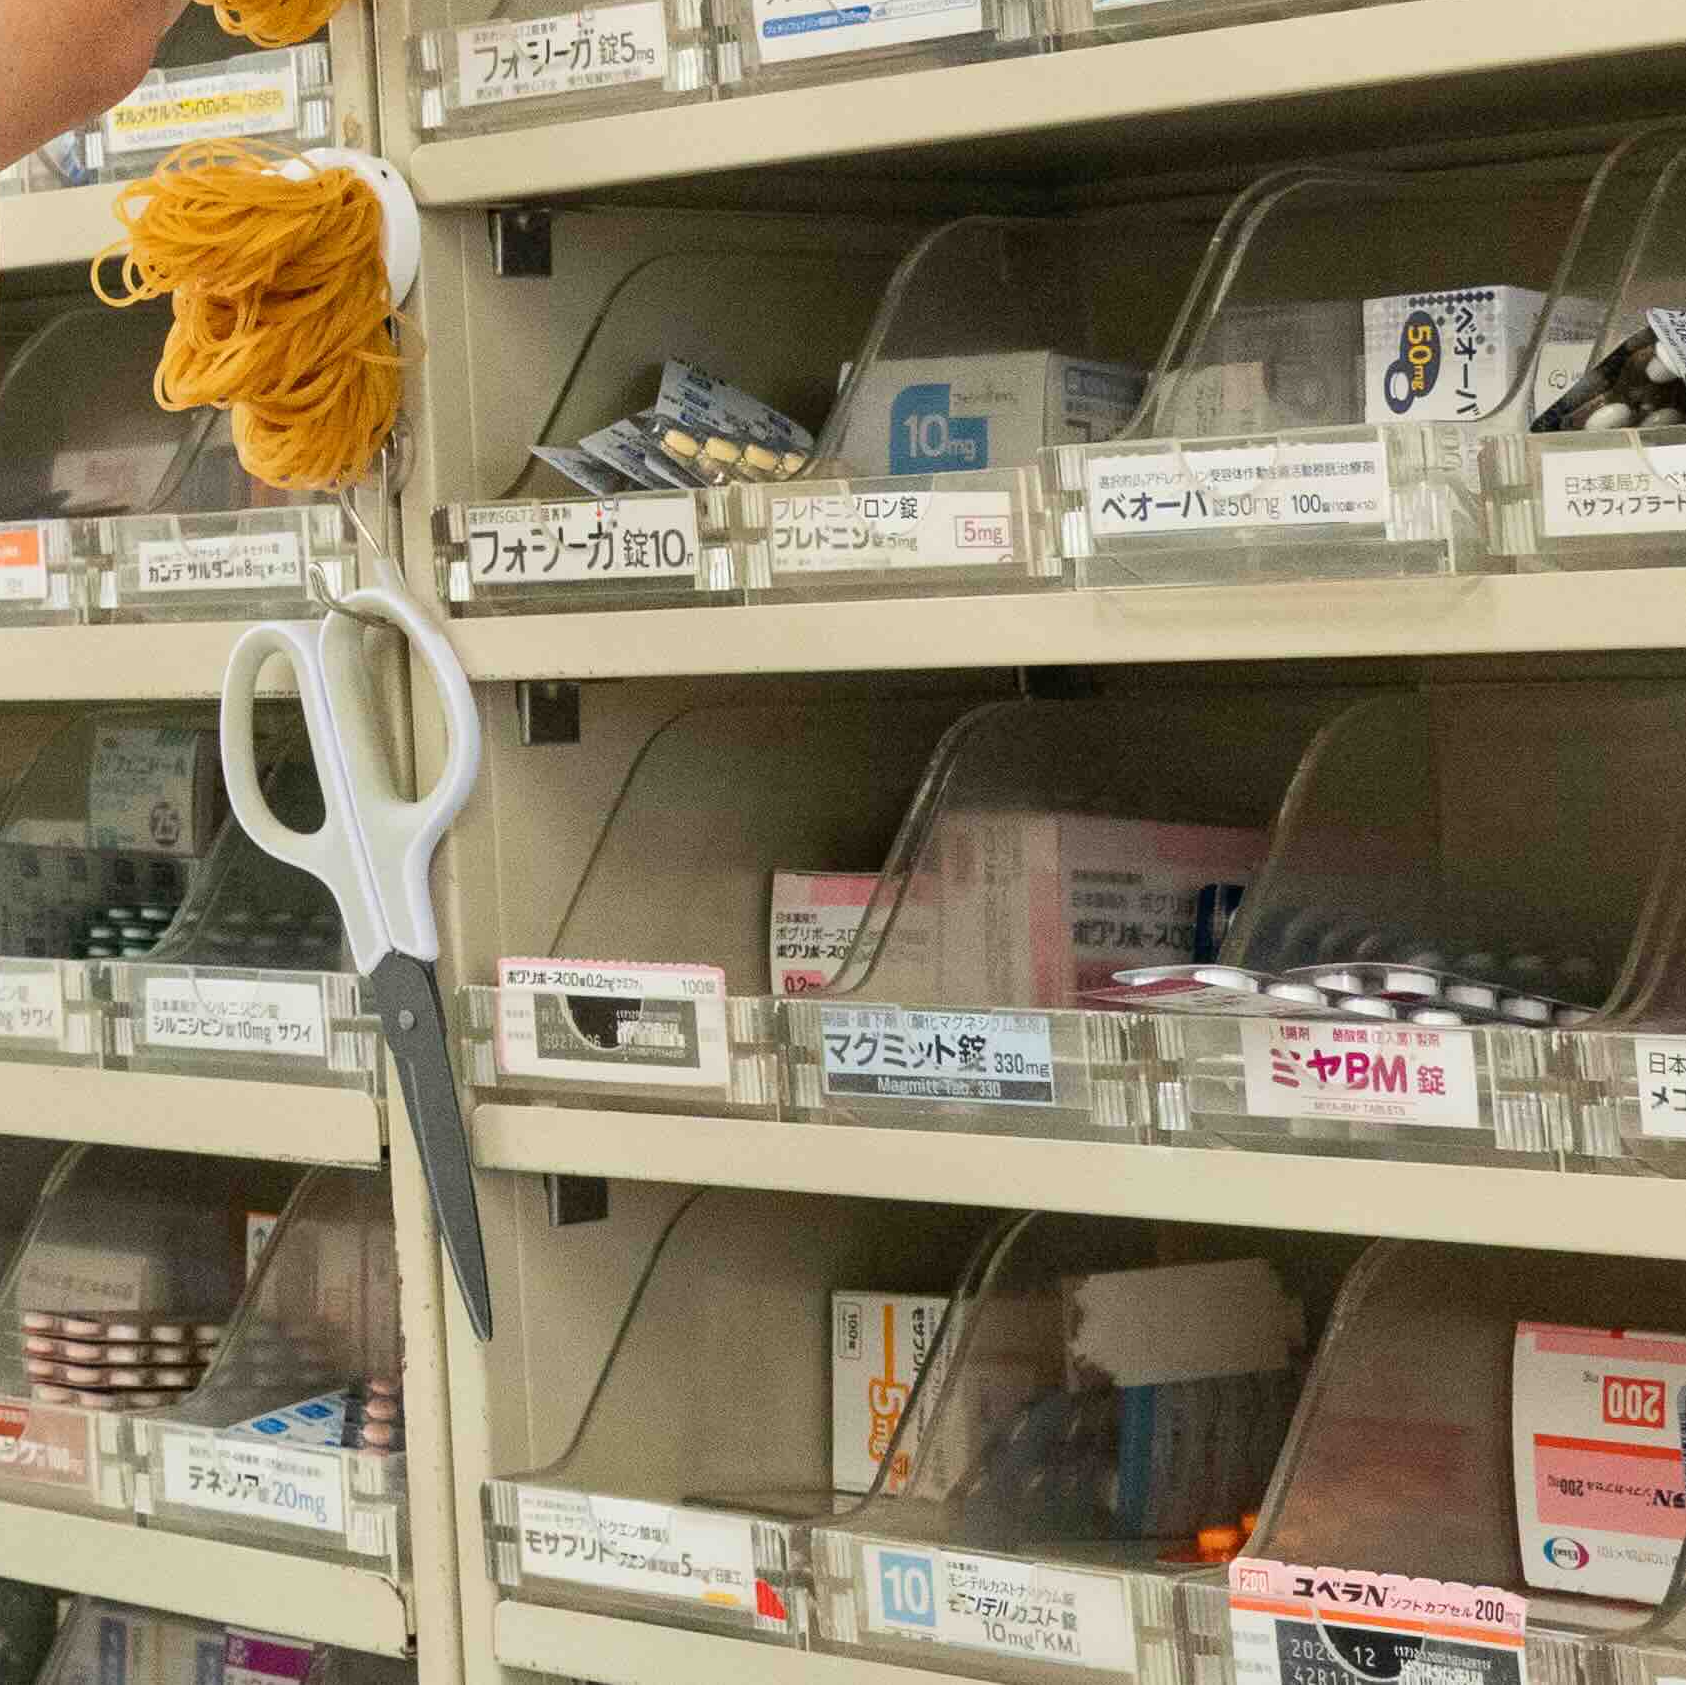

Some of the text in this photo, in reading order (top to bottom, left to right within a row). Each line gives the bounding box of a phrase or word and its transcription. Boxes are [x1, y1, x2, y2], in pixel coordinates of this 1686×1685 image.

[1454, 306, 1480, 416] ベオーバ
[902, 413, 978, 462] 10mg
[963, 521, 1004, 545] 5mg
[825, 1033, 1051, 1079] マグミット錠 330mg
[1269, 1047, 1446, 1097] ミヤBM 錠
[1609, 1381, 1660, 1423] 200
[883, 1564, 930, 1616] 10
[1291, 1575, 1391, 1608] ユベラN
